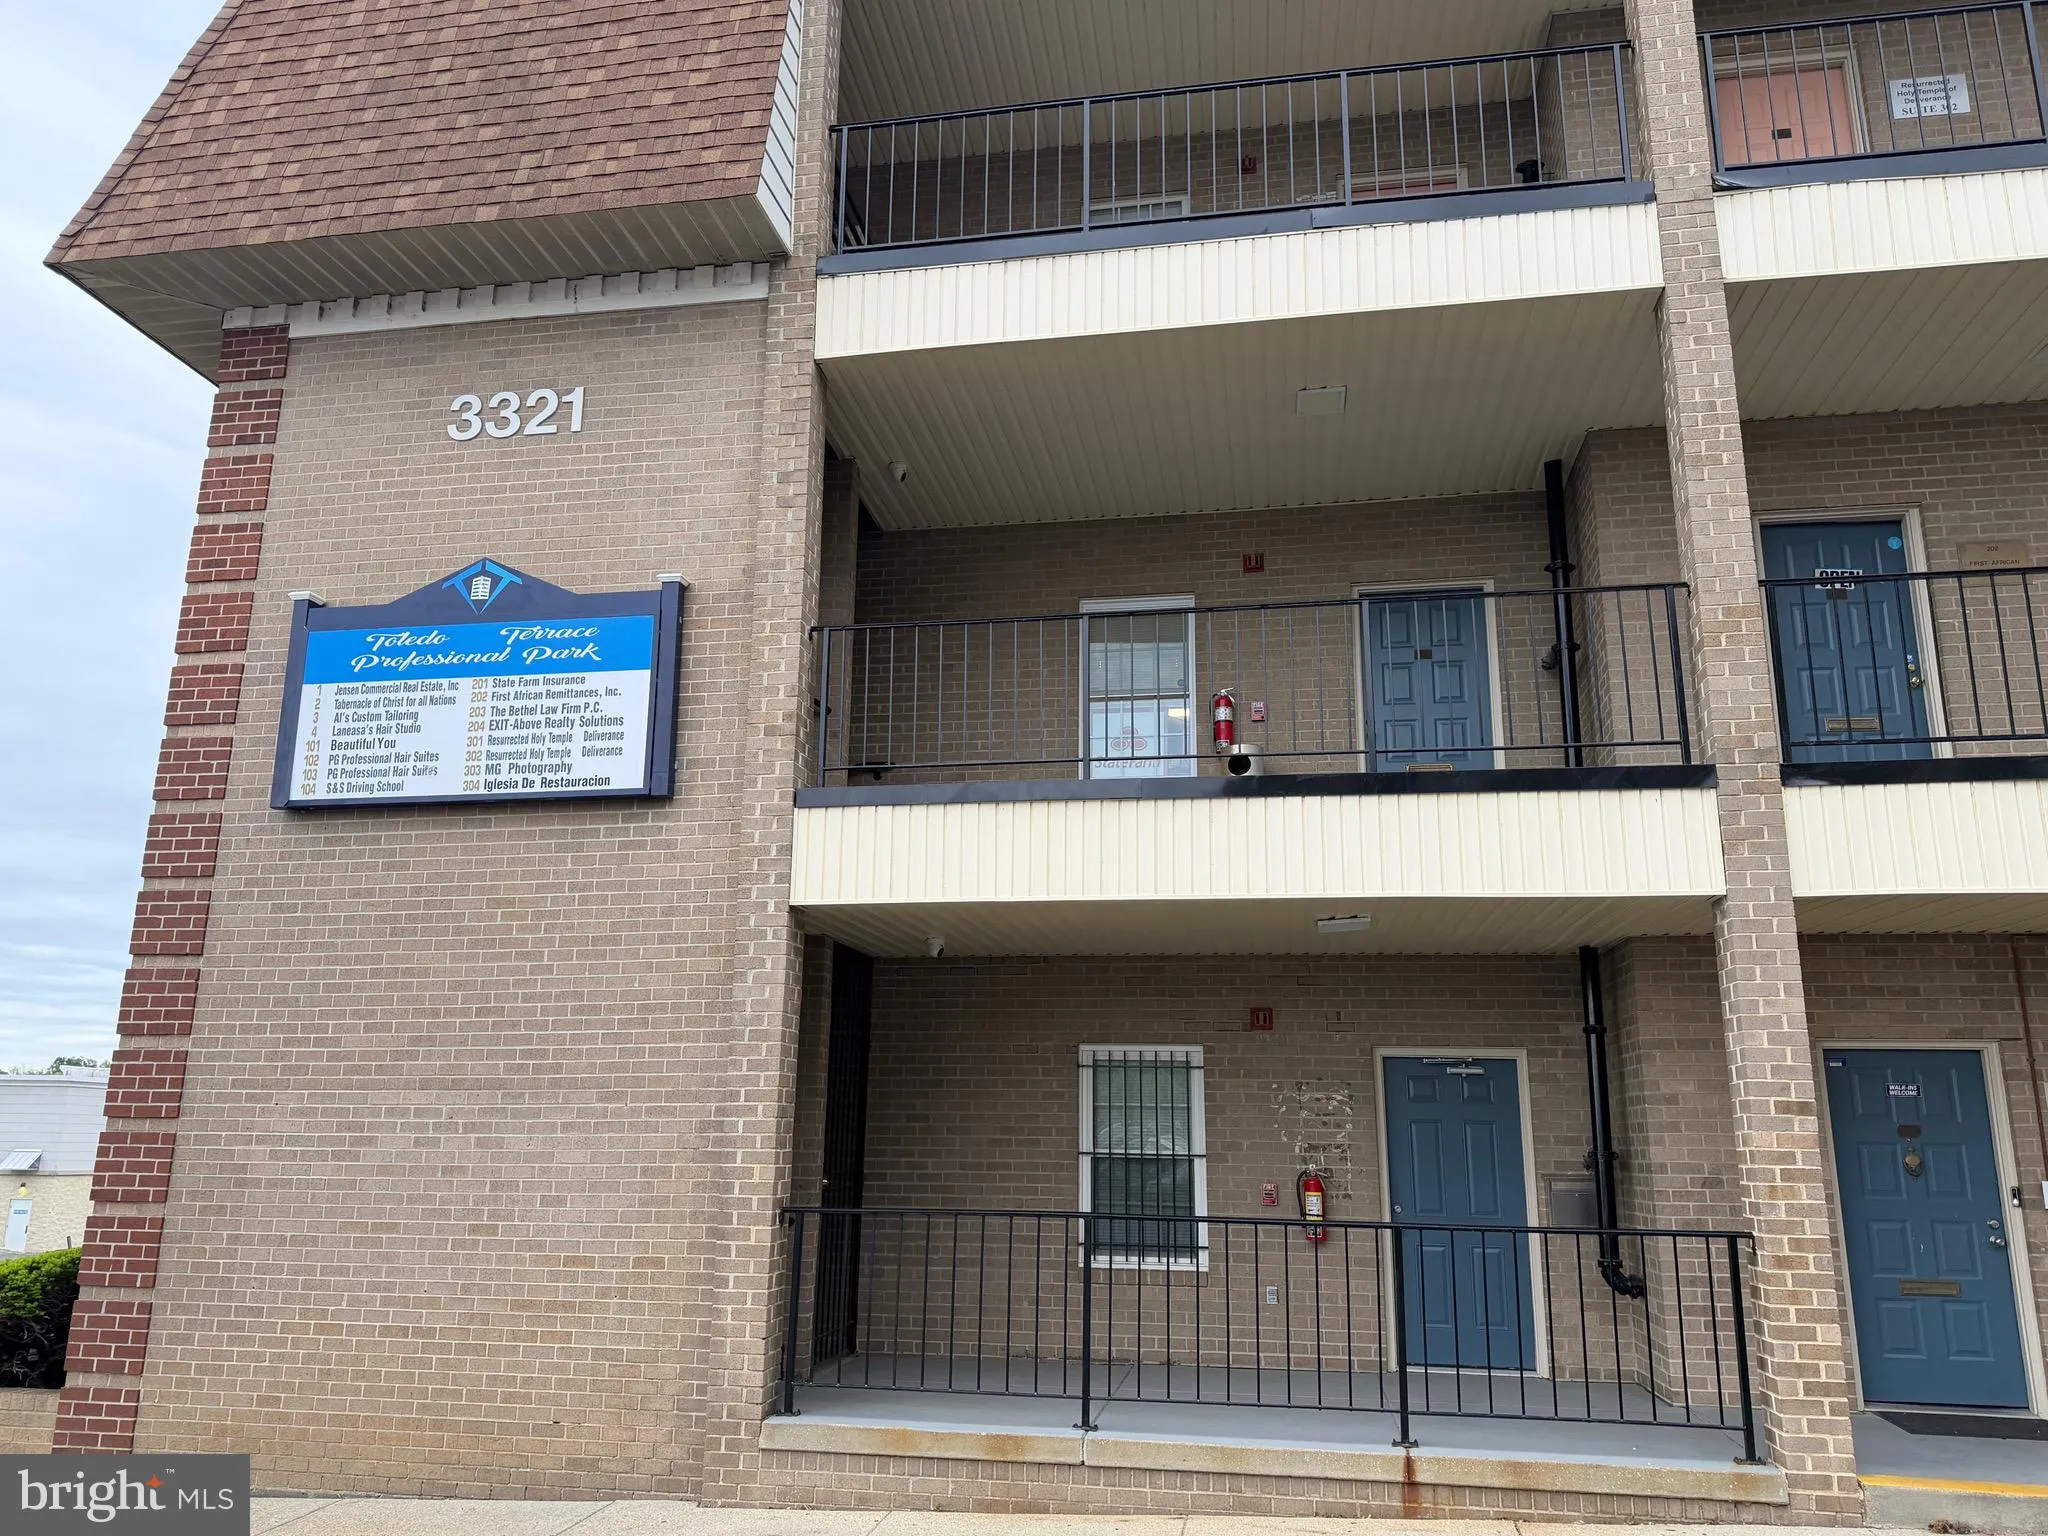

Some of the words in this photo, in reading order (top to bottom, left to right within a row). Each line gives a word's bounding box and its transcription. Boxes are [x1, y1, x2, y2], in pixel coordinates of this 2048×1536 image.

[1905, 95, 1951, 104] Deveranc
[1902, 105, 1937, 115] SUTE
[447, 387, 584, 441] 3321
[366, 630, 450, 651] Toledo
[500, 625, 600, 645] Terrace
[351, 646, 511, 672] Professional
[522, 643, 602, 664] Park
[317, 685, 322, 695] 1
[335, 685, 359, 696] Jensen
[361, 682, 401, 694] Commercial
[403, 681, 418, 693] Real
[420, 680, 445, 693] Estate,
[448, 680, 458, 691] Inc
[472, 679, 488, 689] 201
[492, 678, 514, 688] State
[518, 677, 539, 687] Farm
[543, 676, 585, 686] Insurance
[315, 700, 320, 709] 2
[335, 698, 372, 709] Tabernacle
[374, 697, 381, 708] of
[383, 696, 404, 707] Christ
[406, 696, 416, 706] for
[418, 695, 427, 706] all
[429, 694, 456, 705] Nations
[471, 692, 487, 702] 202
[491, 691, 510, 701] First
[513, 690, 543, 700] African
[545, 688, 602, 699] Remittances,
[605, 686, 622, 697] Inc.
[313, 712, 319, 723] 3
[334, 712, 350, 723] Al's
[352, 711, 381, 723] Custom
[385, 710, 418, 722] Tailoring
[469, 707, 486, 717] 203
[491, 706, 506, 717] The
[509, 704, 537, 716] Bethel
[541, 704, 558, 715] Law
[561, 703, 580, 714] Firm
[584, 702, 602, 713] P.C.
[312, 726, 317, 737] 4
[332, 724, 373, 736] Laneasa's
[376, 724, 392, 735] Hair
[395, 723, 421, 733] Studio
[468, 721, 484, 732] 204
[489, 718, 541, 731] EXIT-Above
[545, 716, 575, 730] Realty
[579, 715, 624, 728] Solutions
[306, 741, 320, 751] 101
[331, 739, 375, 750] Beautiful
[378, 738, 396, 749] You
[467, 736, 483, 747] 301
[488, 733, 529, 746] Resurrected
[531, 732, 546, 745] Holy
[549, 731, 572, 745] Temple
[584, 730, 624, 742] Deliverance
[304, 755, 319, 766] 102
[329, 754, 339, 765] PG
[342, 752, 391, 765] Professional
[394, 752, 411, 763] Hair
[413, 751, 439, 762] Suites
[465, 751, 482, 762] 302
[486, 749, 527, 761] Resurrected
[529, 748, 544, 761] Holy
[547, 747, 571, 760] Temple
[582, 745, 622, 757] Deliverance
[302, 769, 317, 780] 103
[327, 768, 338, 779] PG
[340, 767, 391, 779] Professional
[393, 766, 410, 777] Hair
[412, 765, 438, 776] Suites
[464, 765, 481, 776] 303
[485, 764, 501, 775] MG
[508, 762, 572, 775] Photography
[301, 784, 316, 795] 104
[327, 783, 344, 794] S&S
[347, 782, 374, 794] Driving
[376, 780, 403, 792] School
[463, 780, 480, 791] 304
[484, 779, 518, 792] Iglesia
[522, 778, 534, 789] De
[541, 775, 610, 789] Restauracion
